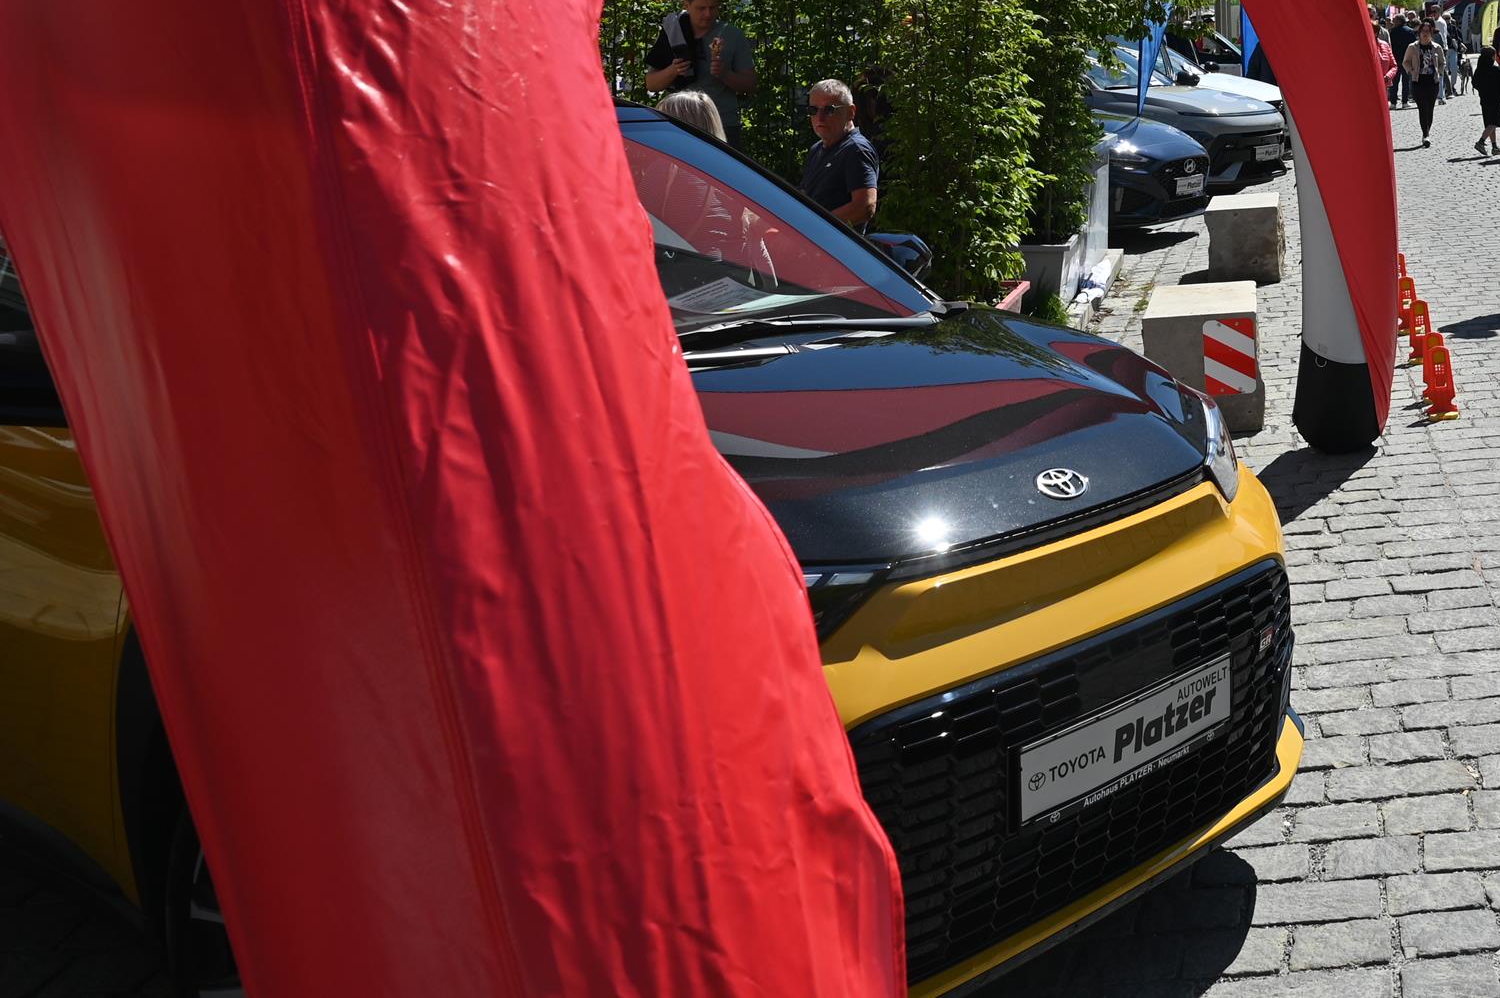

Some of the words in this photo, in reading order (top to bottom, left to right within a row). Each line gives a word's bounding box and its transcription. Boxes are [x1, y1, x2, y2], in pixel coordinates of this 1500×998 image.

[1176, 665, 1229, 703] AUTOWELT
[1048, 745, 1107, 783] TOYOTA
[1112, 686, 1217, 764] Platzer
[1083, 782, 1119, 808] Autohaus
[1158, 745, 1191, 769] Neumarkt
